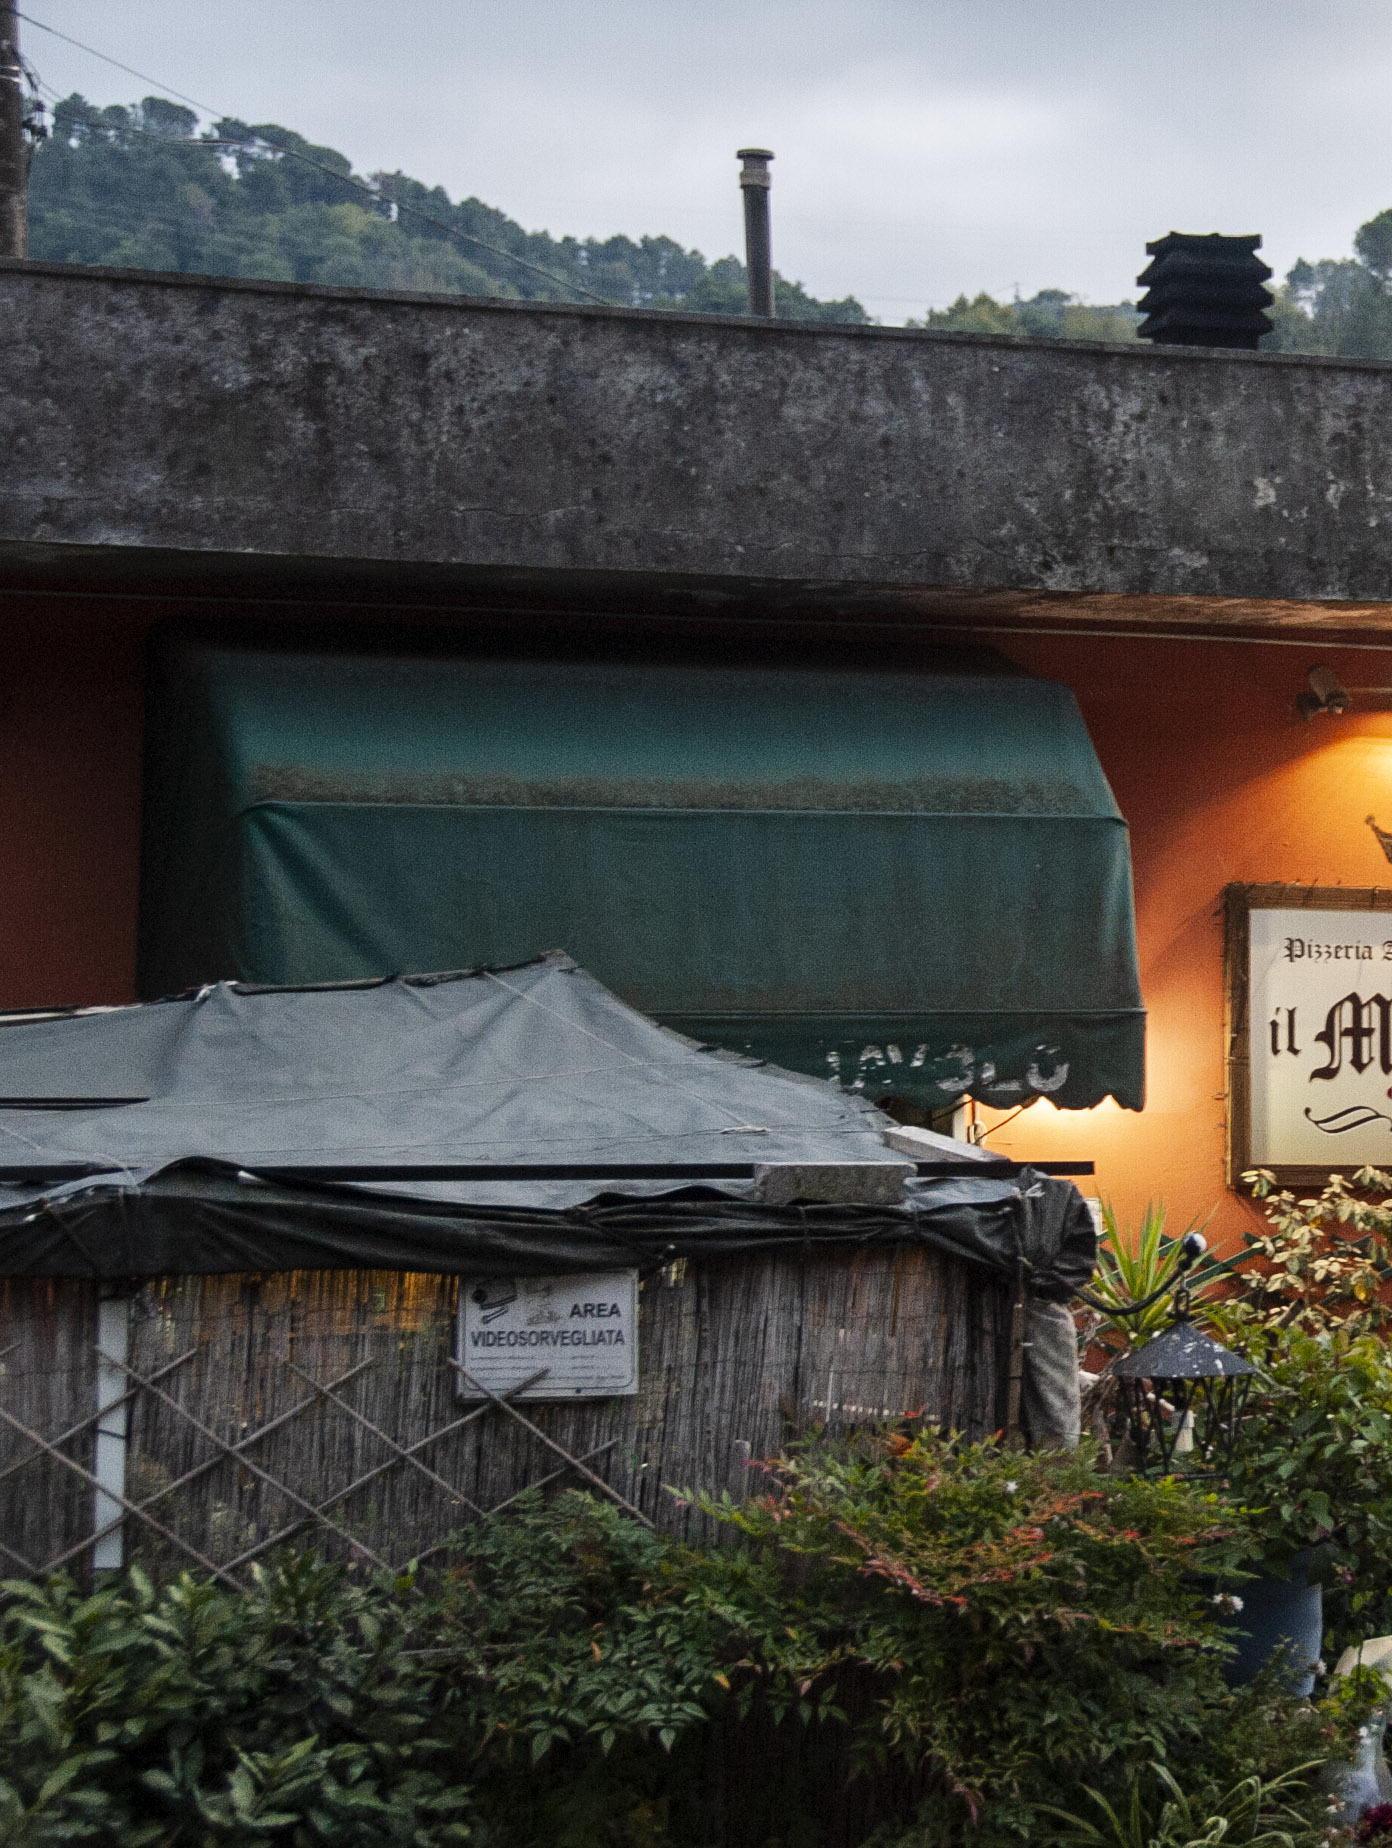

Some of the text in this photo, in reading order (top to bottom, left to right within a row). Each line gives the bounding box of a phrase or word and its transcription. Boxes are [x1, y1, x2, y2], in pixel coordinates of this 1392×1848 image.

[1284, 937, 1373, 963] Pizzeria
[1269, 1006, 1302, 1056] il
[569, 1302, 621, 1318] AREA
[470, 1329, 625, 1347] VIDEOSORVEGLIATA
